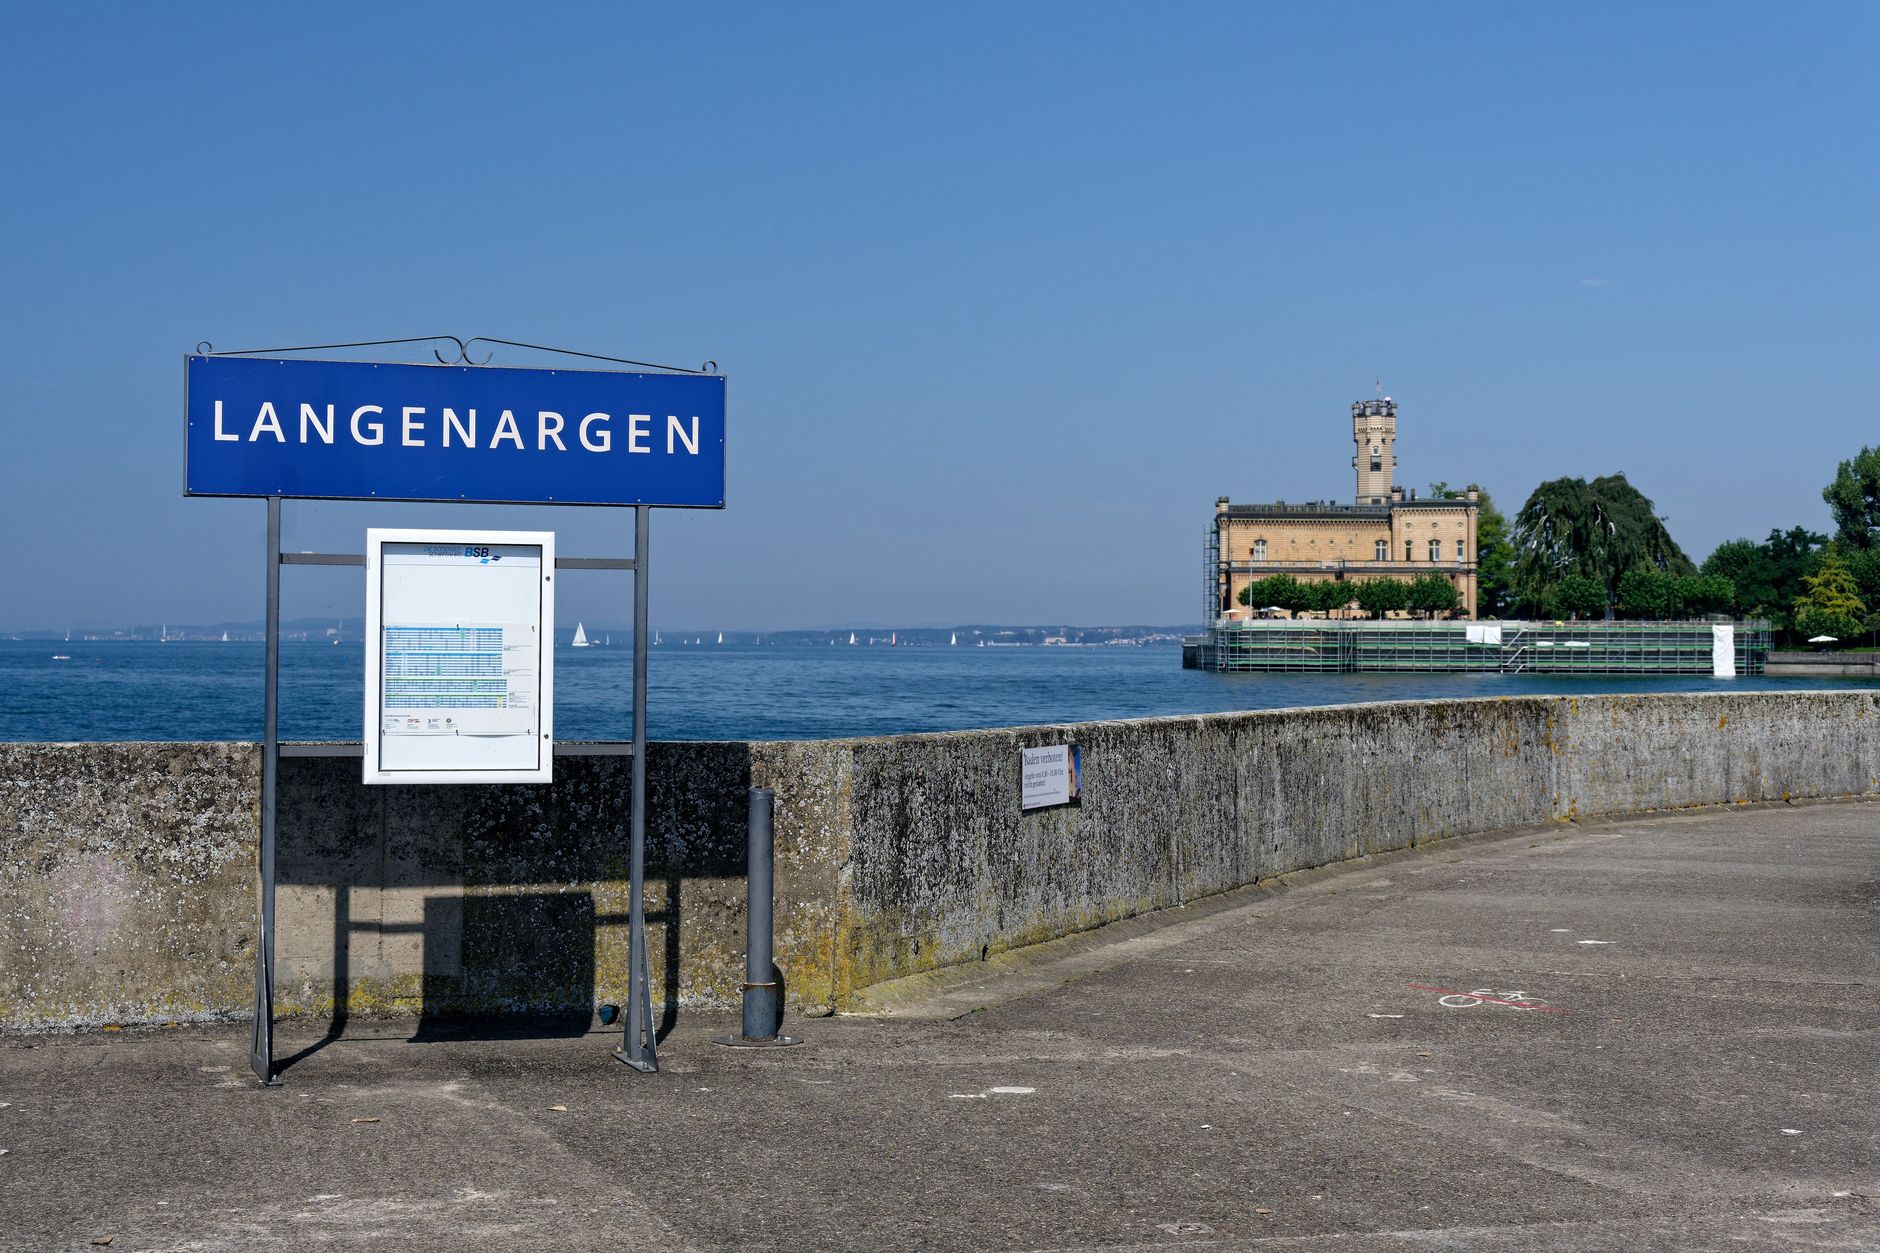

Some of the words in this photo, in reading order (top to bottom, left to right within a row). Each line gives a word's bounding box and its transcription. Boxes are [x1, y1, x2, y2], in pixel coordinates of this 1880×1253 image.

[213, 400, 700, 455] LANGENARGEN
[464, 547, 489, 558] BSB
[1023, 752, 1039, 766] Baden
[1040, 751, 1064, 764] verboten!
